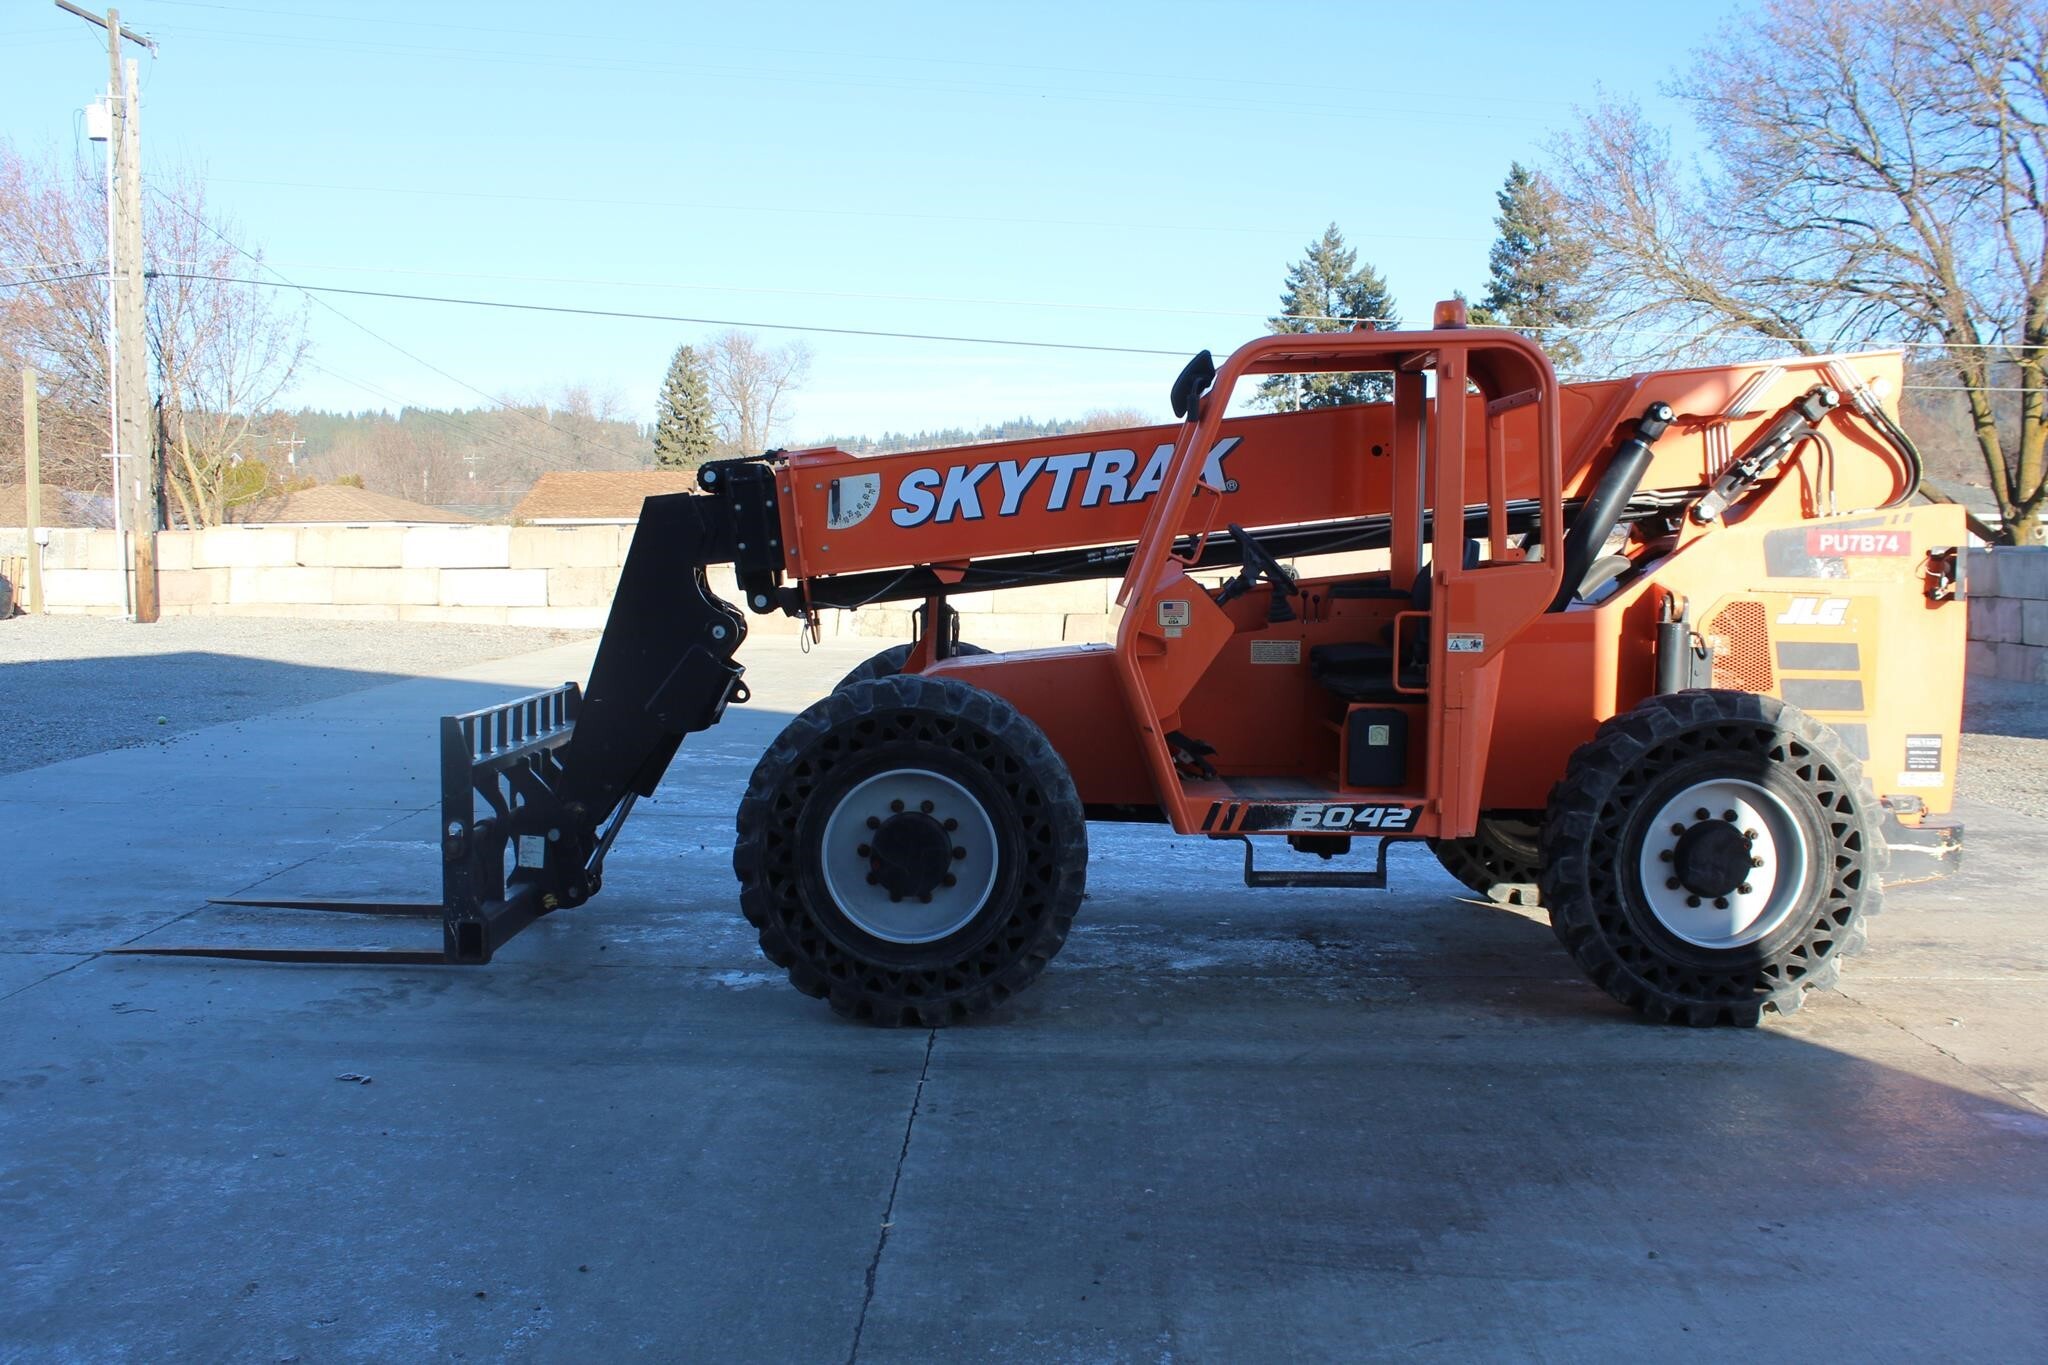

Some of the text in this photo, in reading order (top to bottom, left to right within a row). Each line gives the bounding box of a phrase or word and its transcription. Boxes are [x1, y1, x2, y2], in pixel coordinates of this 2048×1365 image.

[1819, 533, 1900, 552] PU7B74
[1775, 597, 1850, 625] JLG
[1291, 803, 1412, 829] 6042
